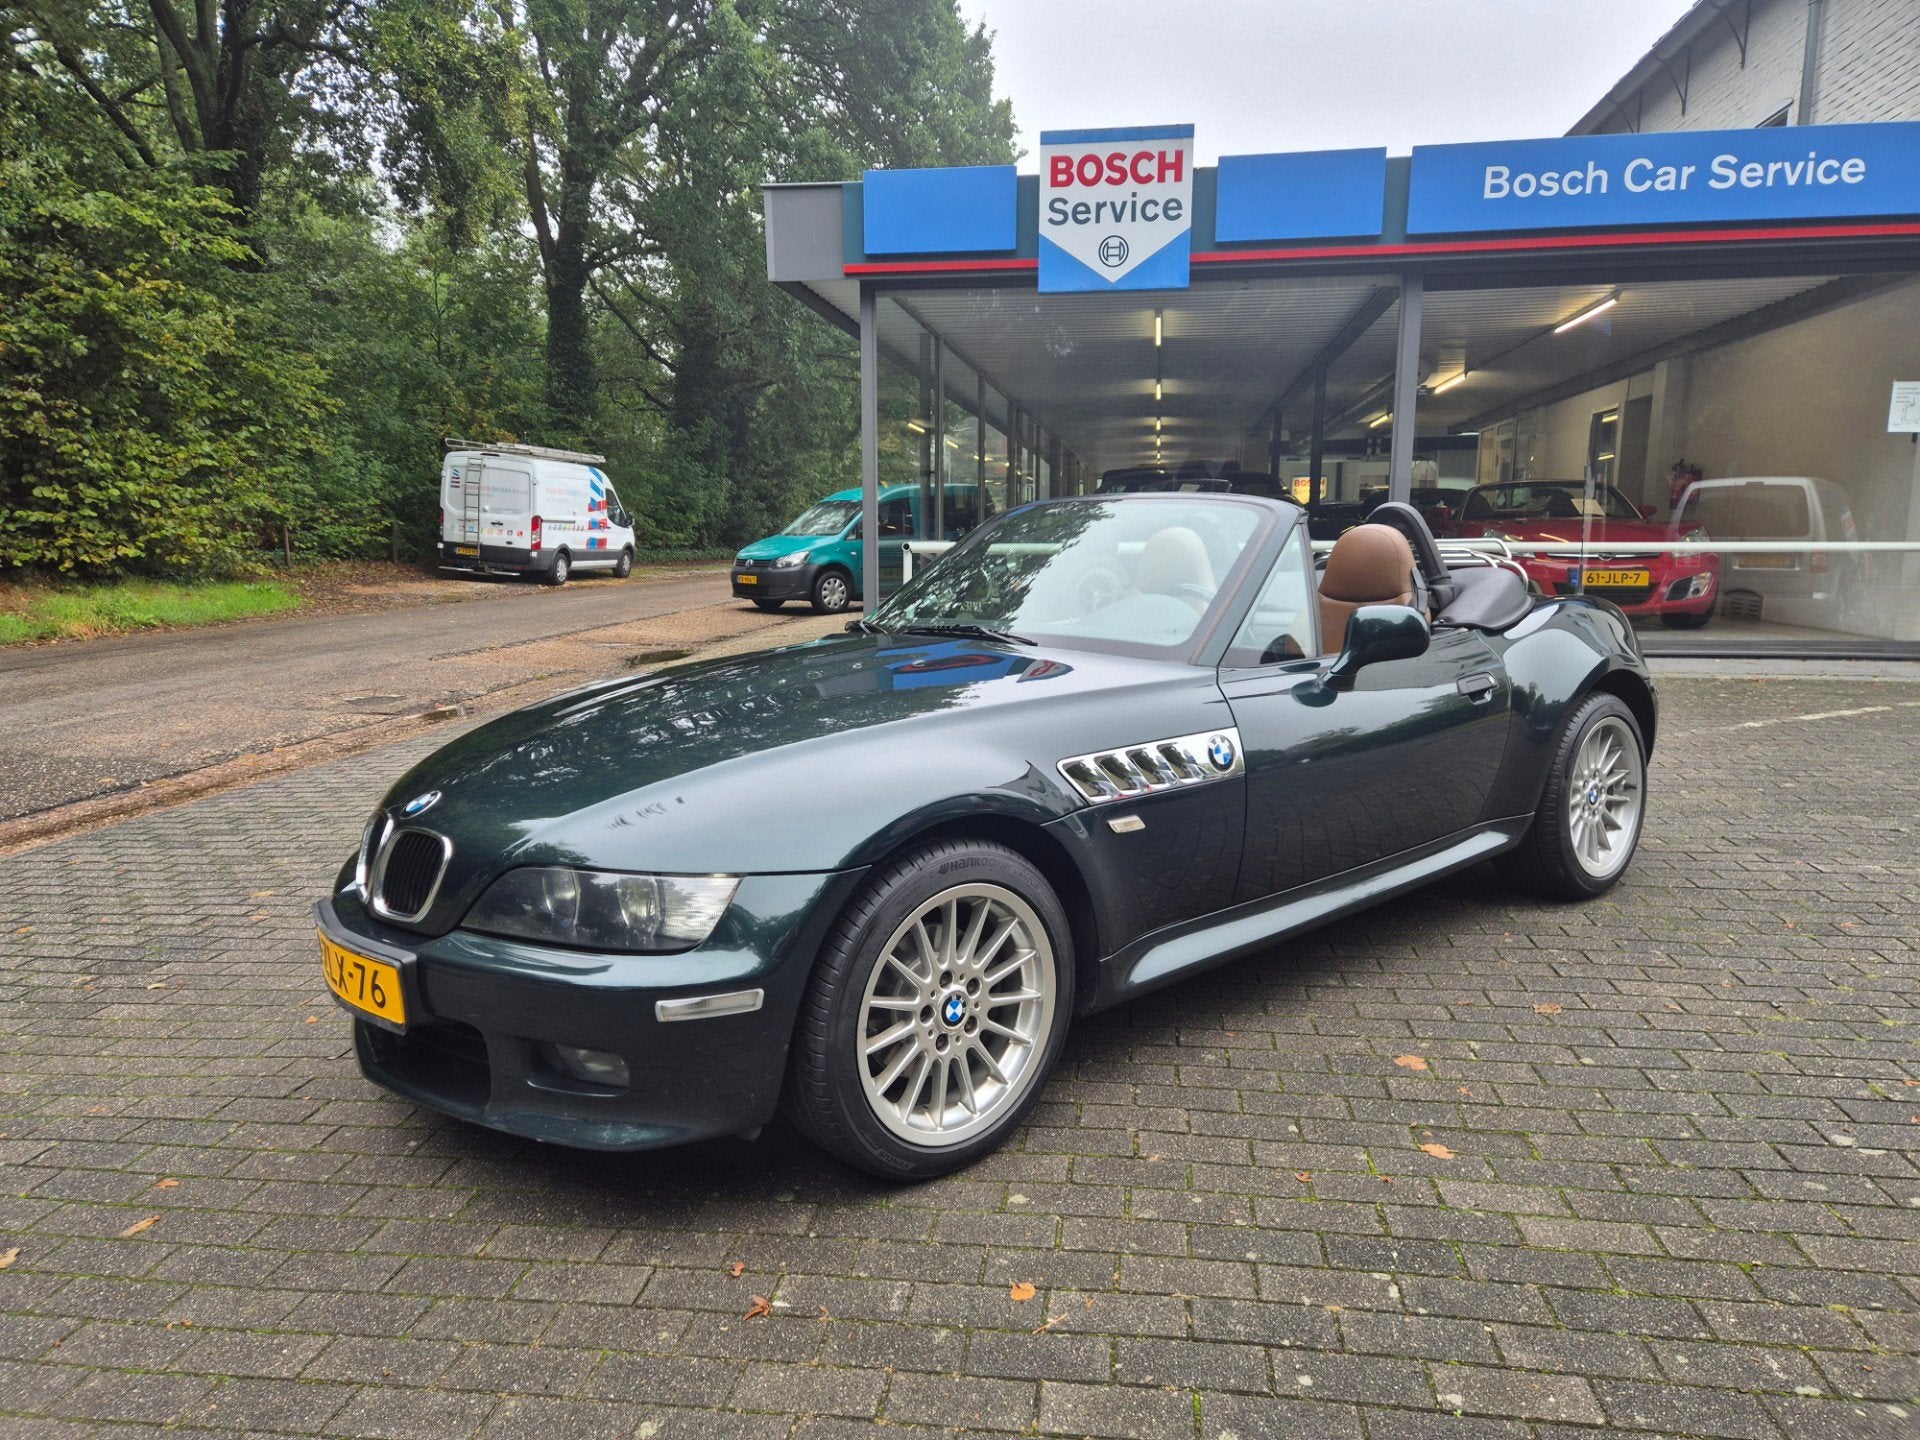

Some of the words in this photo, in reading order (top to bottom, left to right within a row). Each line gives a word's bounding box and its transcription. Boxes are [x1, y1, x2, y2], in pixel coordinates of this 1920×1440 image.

[1050, 150, 1183, 188] BOSCH
[1483, 161, 1608, 199] Bosch
[1623, 157, 1695, 192] Car
[1708, 151, 1866, 190] Service
[1047, 192, 1183, 226] Service
[1586, 571, 1641, 584] 61-JLP-7
